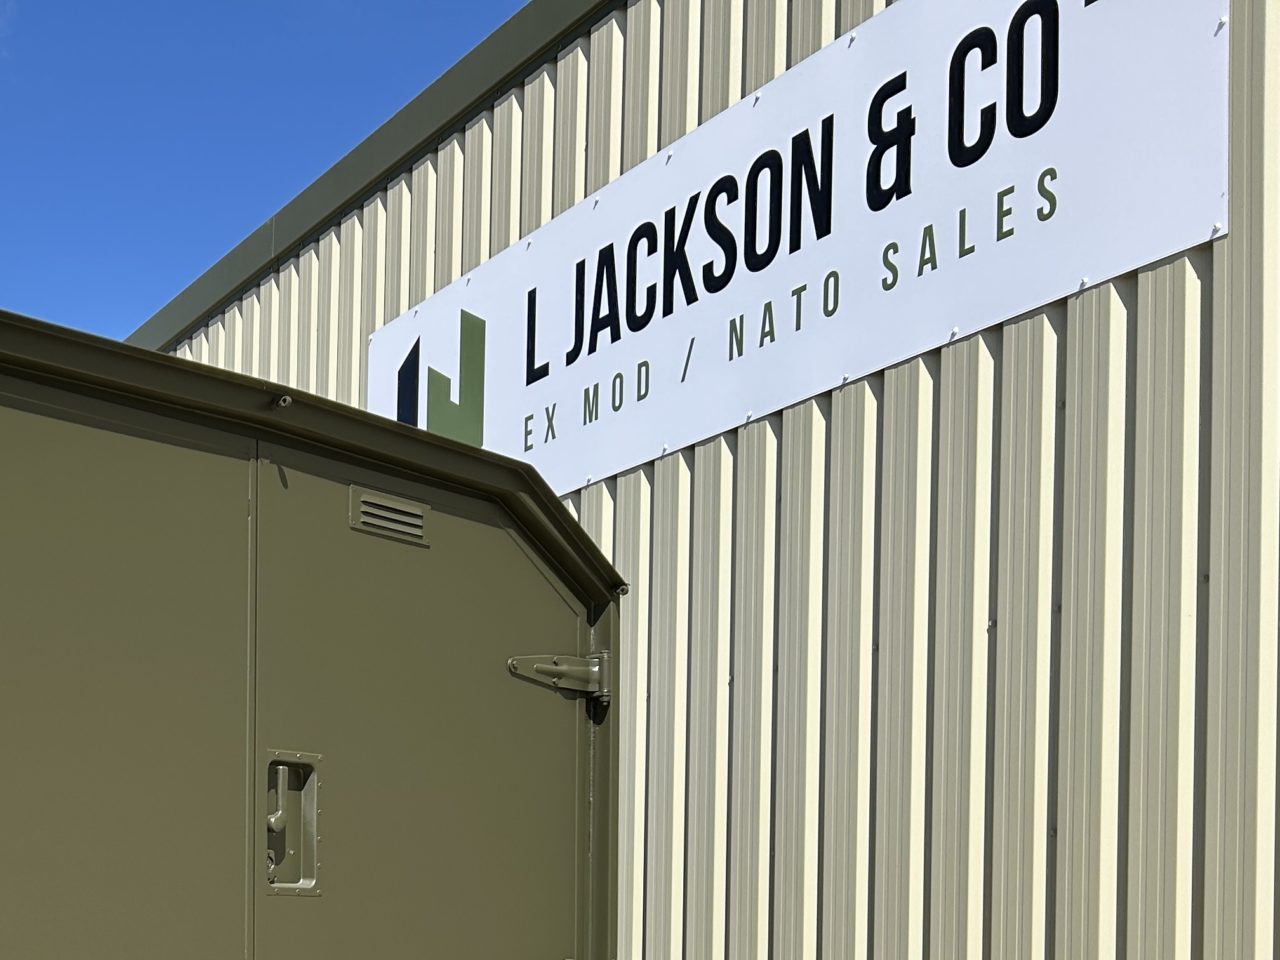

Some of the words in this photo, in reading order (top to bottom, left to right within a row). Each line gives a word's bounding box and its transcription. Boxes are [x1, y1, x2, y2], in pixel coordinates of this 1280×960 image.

[523, 402, 557, 453] EX
[583, 360, 650, 426] MOD
[680, 336, 696, 384] /
[727, 270, 841, 362] NATO
[881, 167, 1059, 292] SALES
[525, 286, 550, 387] L
[565, 113, 835, 368] JACKSON
[865, 70, 917, 213] &
[947, 0, 1060, 169] CO
